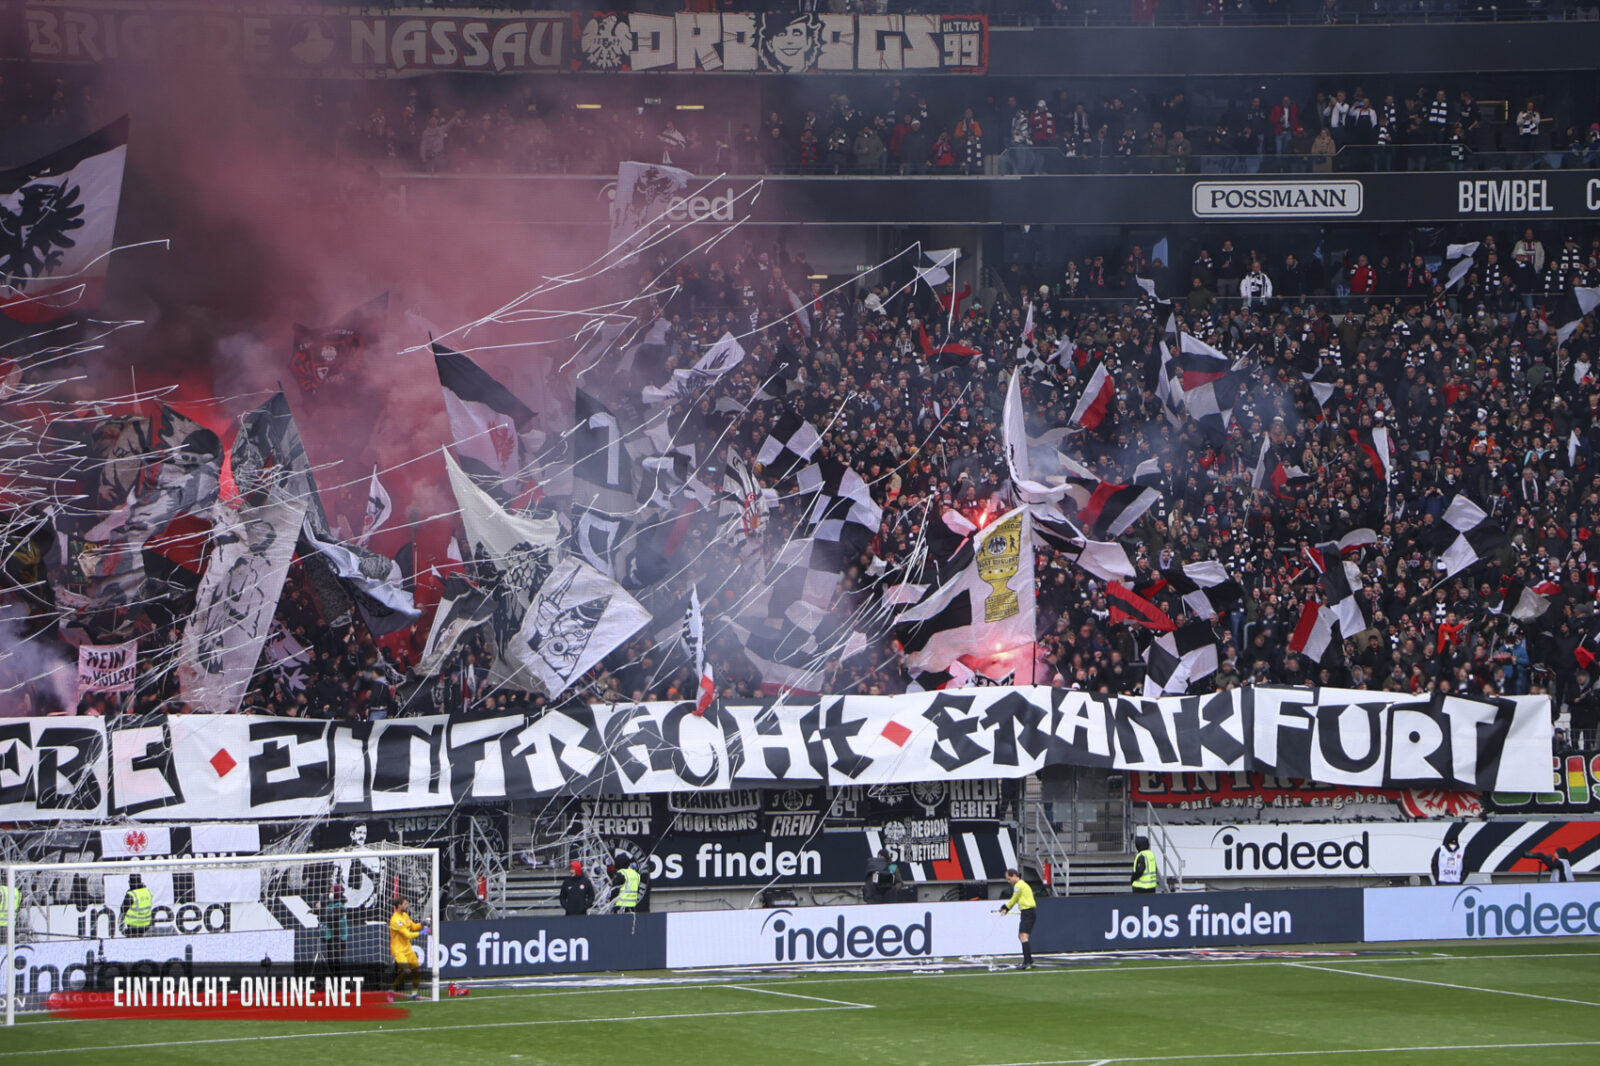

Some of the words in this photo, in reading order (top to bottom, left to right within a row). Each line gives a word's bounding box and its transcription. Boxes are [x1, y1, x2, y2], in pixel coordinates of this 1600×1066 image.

[25, 10, 272, 64] BRIGDE
[351, 18, 565, 71] NASSAU
[943, 21, 980, 32] ULTRAS
[944, 33, 980, 66] 99
[604, 184, 735, 222] ieed
[1210, 188, 1347, 209] POSSMANN
[1458, 178, 1554, 213] BEMBEL
[87, 649, 126, 669] NEIN
[922, 686, 1498, 785] FRANKFURT
[673, 788, 758, 809] FRANKFURT
[950, 779, 998, 801] RIED
[1181, 796, 1212, 811] auf
[1222, 794, 1265, 809] ewig
[1273, 794, 1303, 808] dir
[1311, 792, 1388, 809] ergeben
[674, 812, 759, 832] HOOLIGANS
[950, 801, 998, 819] GEBIET
[770, 814, 817, 837] CREW
[911, 817, 949, 838] REGION
[696, 842, 822, 878] finden
[911, 842, 950, 862] WETTERAU
[1222, 829, 1370, 871] indeed
[76, 902, 231, 939] ineed
[1104, 905, 1180, 940] Jobs
[1187, 901, 1292, 937] finden
[410, 934, 467, 969] obs
[477, 930, 589, 966] finden
[773, 911, 932, 961] indeed
